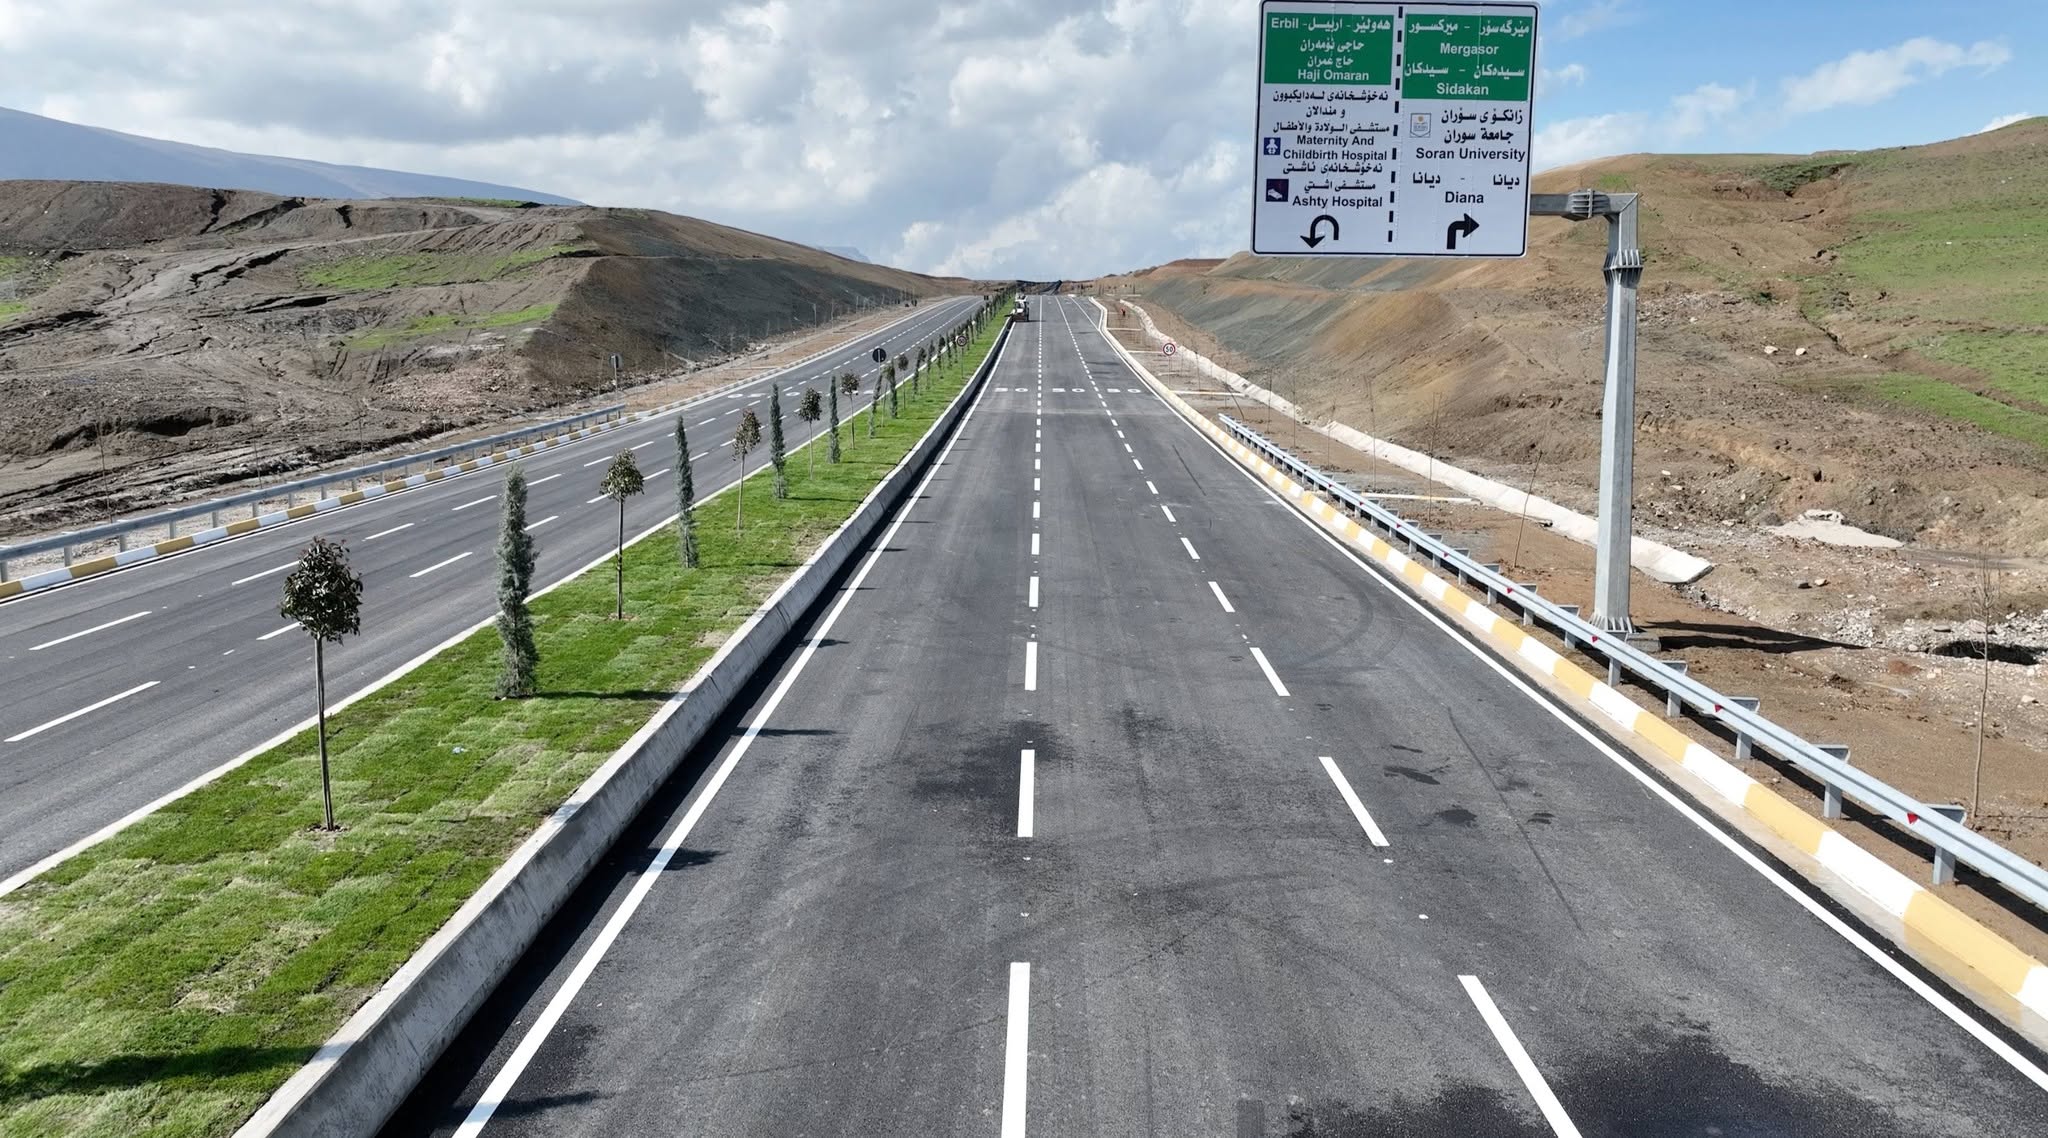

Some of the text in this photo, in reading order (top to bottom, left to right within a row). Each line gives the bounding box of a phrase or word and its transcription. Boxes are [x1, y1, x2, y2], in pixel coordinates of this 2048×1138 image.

[1271, 17, 1299, 29] Erbil
[1440, 43, 1499, 57] Mergasor
[1307, 55, 1354, 68] حاج عمران
[1298, 69, 1369, 82] Haji Omaran
[1436, 82, 1489, 95] Sidakan
[1296, 135, 1374, 147] Maternity And
[1444, 127, 1514, 144] جامعة سوران
[1283, 149, 1387, 163] Childbirth Hospital
[1416, 147, 1526, 162] Soran University
[1292, 195, 1383, 209] Ashty Hospital
[1445, 191, 1485, 204] Diana
